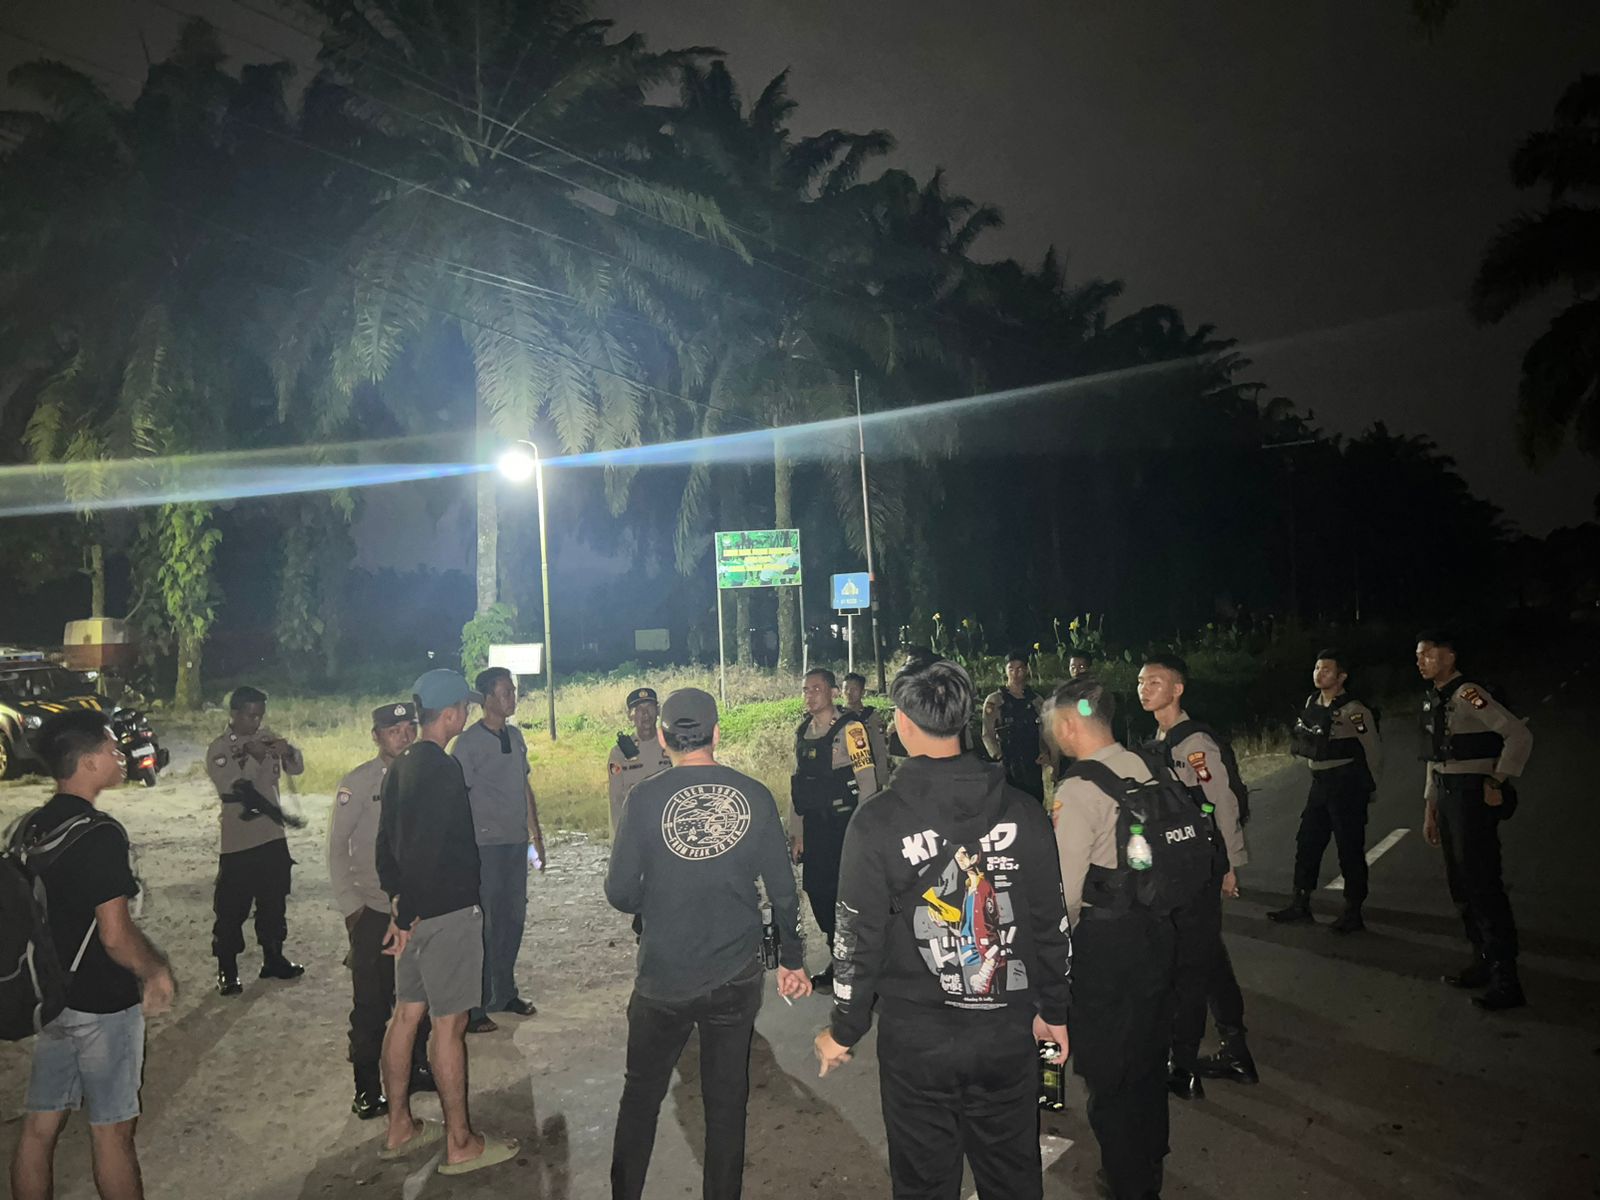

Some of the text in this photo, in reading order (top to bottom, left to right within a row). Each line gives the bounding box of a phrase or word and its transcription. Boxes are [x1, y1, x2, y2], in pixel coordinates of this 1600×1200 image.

[673, 786, 737, 804] EIGER 1989
[668, 830, 742, 858] FROM PEAK TO SEA
[1165, 825, 1196, 844] POLRI
